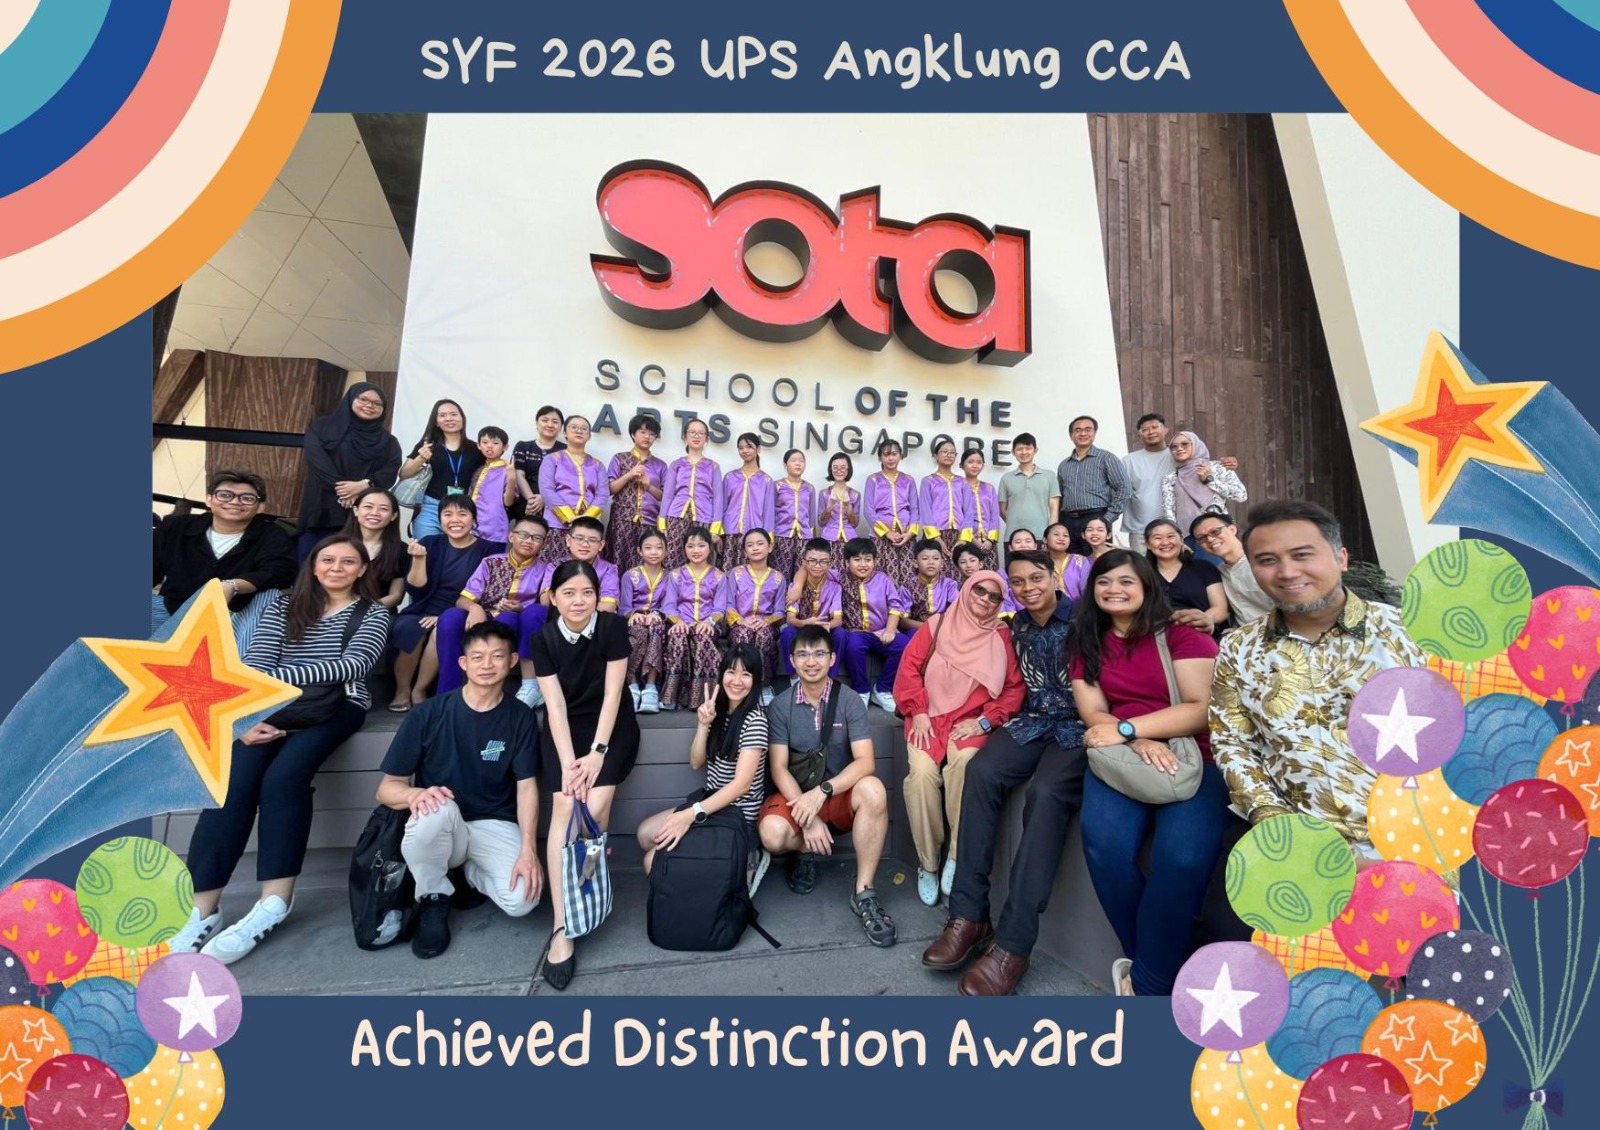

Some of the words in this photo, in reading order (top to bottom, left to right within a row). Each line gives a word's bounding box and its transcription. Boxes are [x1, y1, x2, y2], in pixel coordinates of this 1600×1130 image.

[594, 358, 835, 412] SCHOOL
[854, 386, 909, 417] OF
[925, 393, 1012, 429] THE
